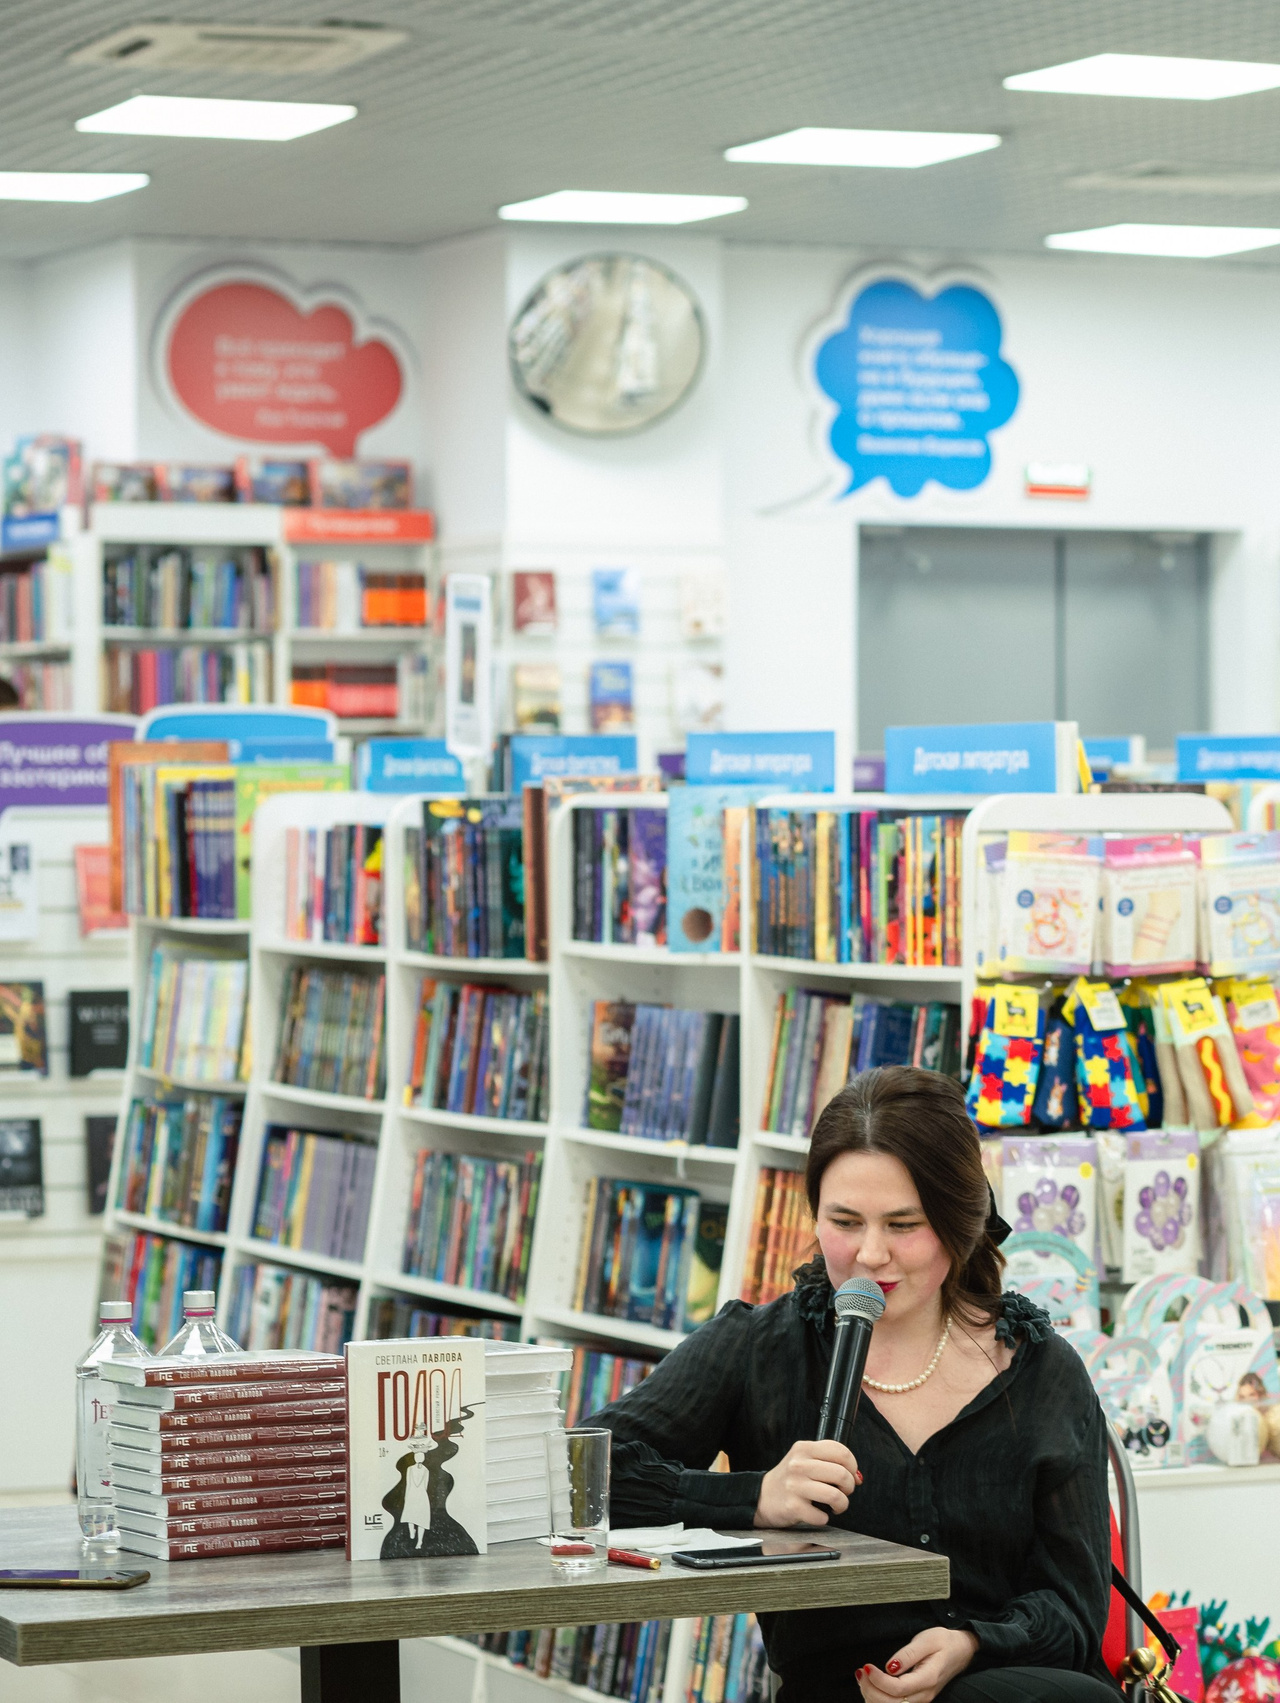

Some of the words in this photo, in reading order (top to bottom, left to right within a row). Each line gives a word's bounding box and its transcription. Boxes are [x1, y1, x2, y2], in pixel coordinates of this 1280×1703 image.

[375, 1355, 418, 1365] СВЕТЛАНА
[422, 1353, 463, 1363] ПАВЛОВА
[210, 1368, 237, 1377] ПАВЛОВА
[237, 1389, 263, 1398] ПАВЛОВА
[377, 1368, 464, 1441] ГОЛОД
[225, 1412, 251, 1421] ПАВЛОВА
[226, 1433, 252, 1441] ПАВЛОВА
[379, 1447, 389, 1458] 18+
[225, 1453, 251, 1463] ПАВЛОВА
[226, 1474, 253, 1483] ПАВЛОВА
[232, 1496, 258, 1505] ПАВЛОВА
[232, 1517, 258, 1526] ПАВЛОВА
[233, 1539, 260, 1547] ПАВЛОВА
